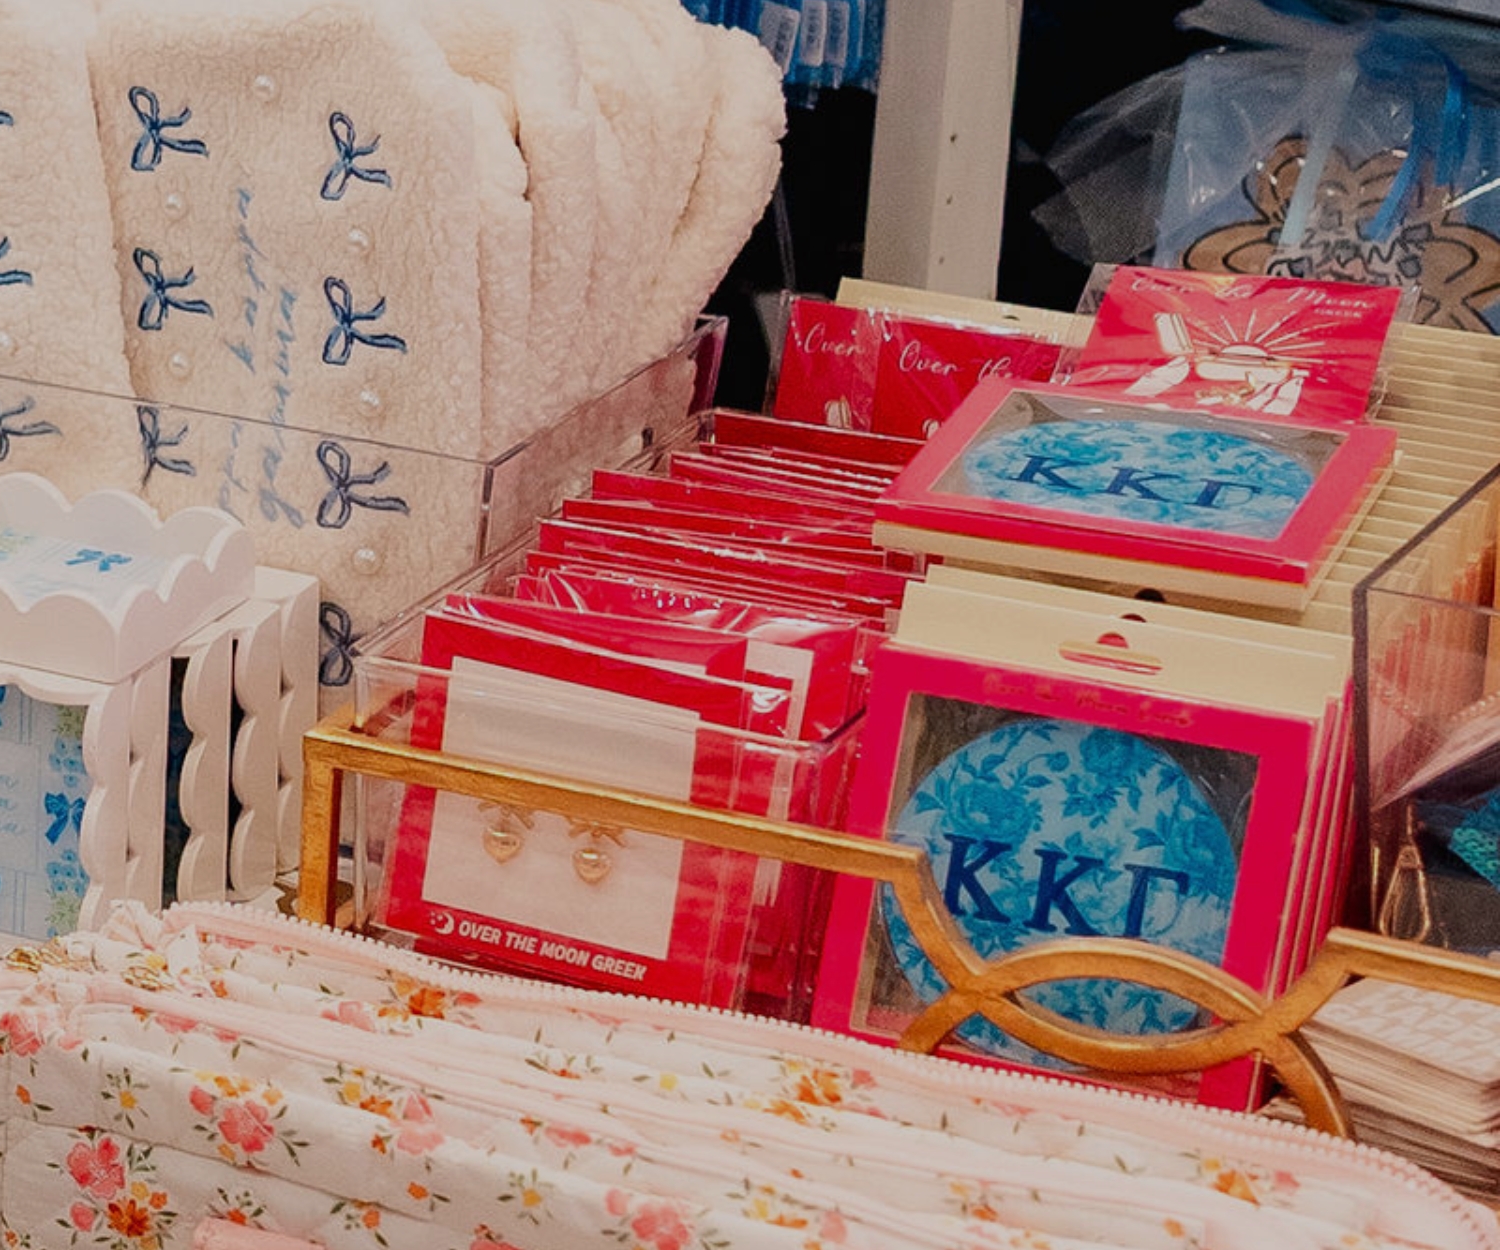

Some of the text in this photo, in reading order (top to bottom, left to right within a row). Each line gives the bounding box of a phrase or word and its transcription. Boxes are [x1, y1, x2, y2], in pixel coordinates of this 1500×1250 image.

[803, 321, 866, 356] Over
[898, 339, 966, 376] Over
[458, 919, 648, 981] OVER THE MOON GREEK
